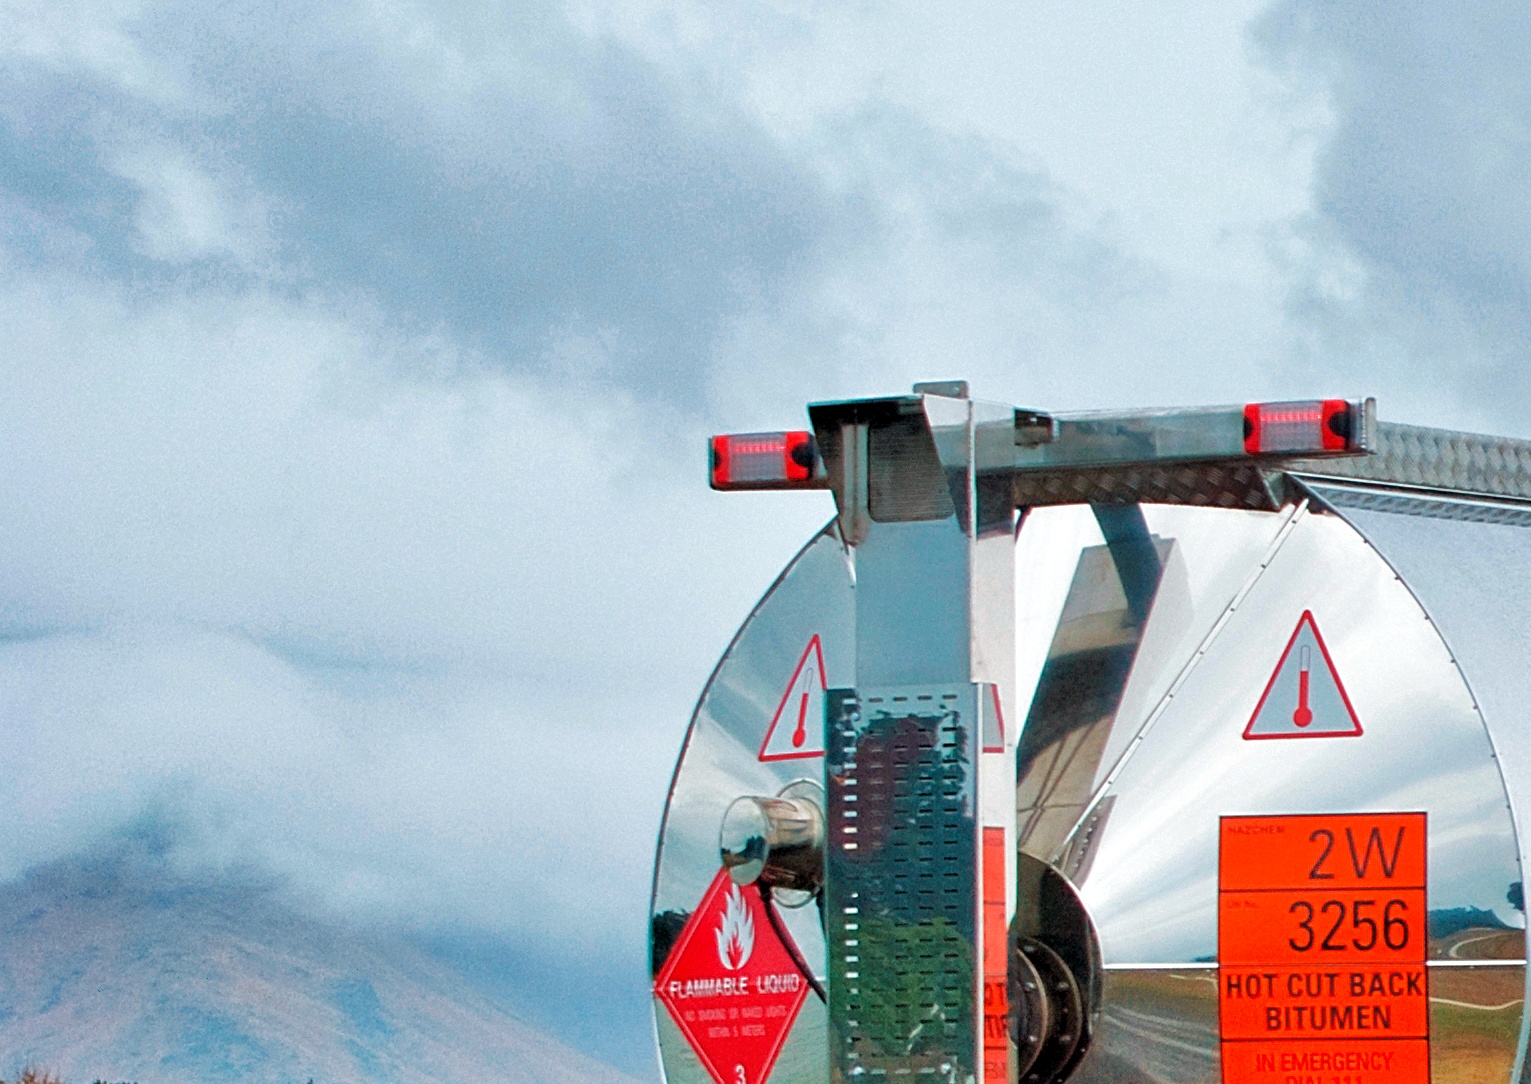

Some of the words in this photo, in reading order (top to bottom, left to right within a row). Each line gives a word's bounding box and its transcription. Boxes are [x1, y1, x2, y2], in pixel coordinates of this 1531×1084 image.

[1309, 827, 1405, 879] 2W
[1289, 899, 1409, 951] 3256
[670, 977, 749, 998] FLAMMABLE
[757, 973, 799, 994] LIQUID
[1227, 974, 1277, 998] HOT
[1287, 973, 1338, 998] CUT
[1350, 972, 1423, 997] BACK
[1266, 1005, 1391, 1030] BITUMEN
[1256, 1053, 1275, 1072] IN
[1281, 1052, 1394, 1071] EMERGENCY
